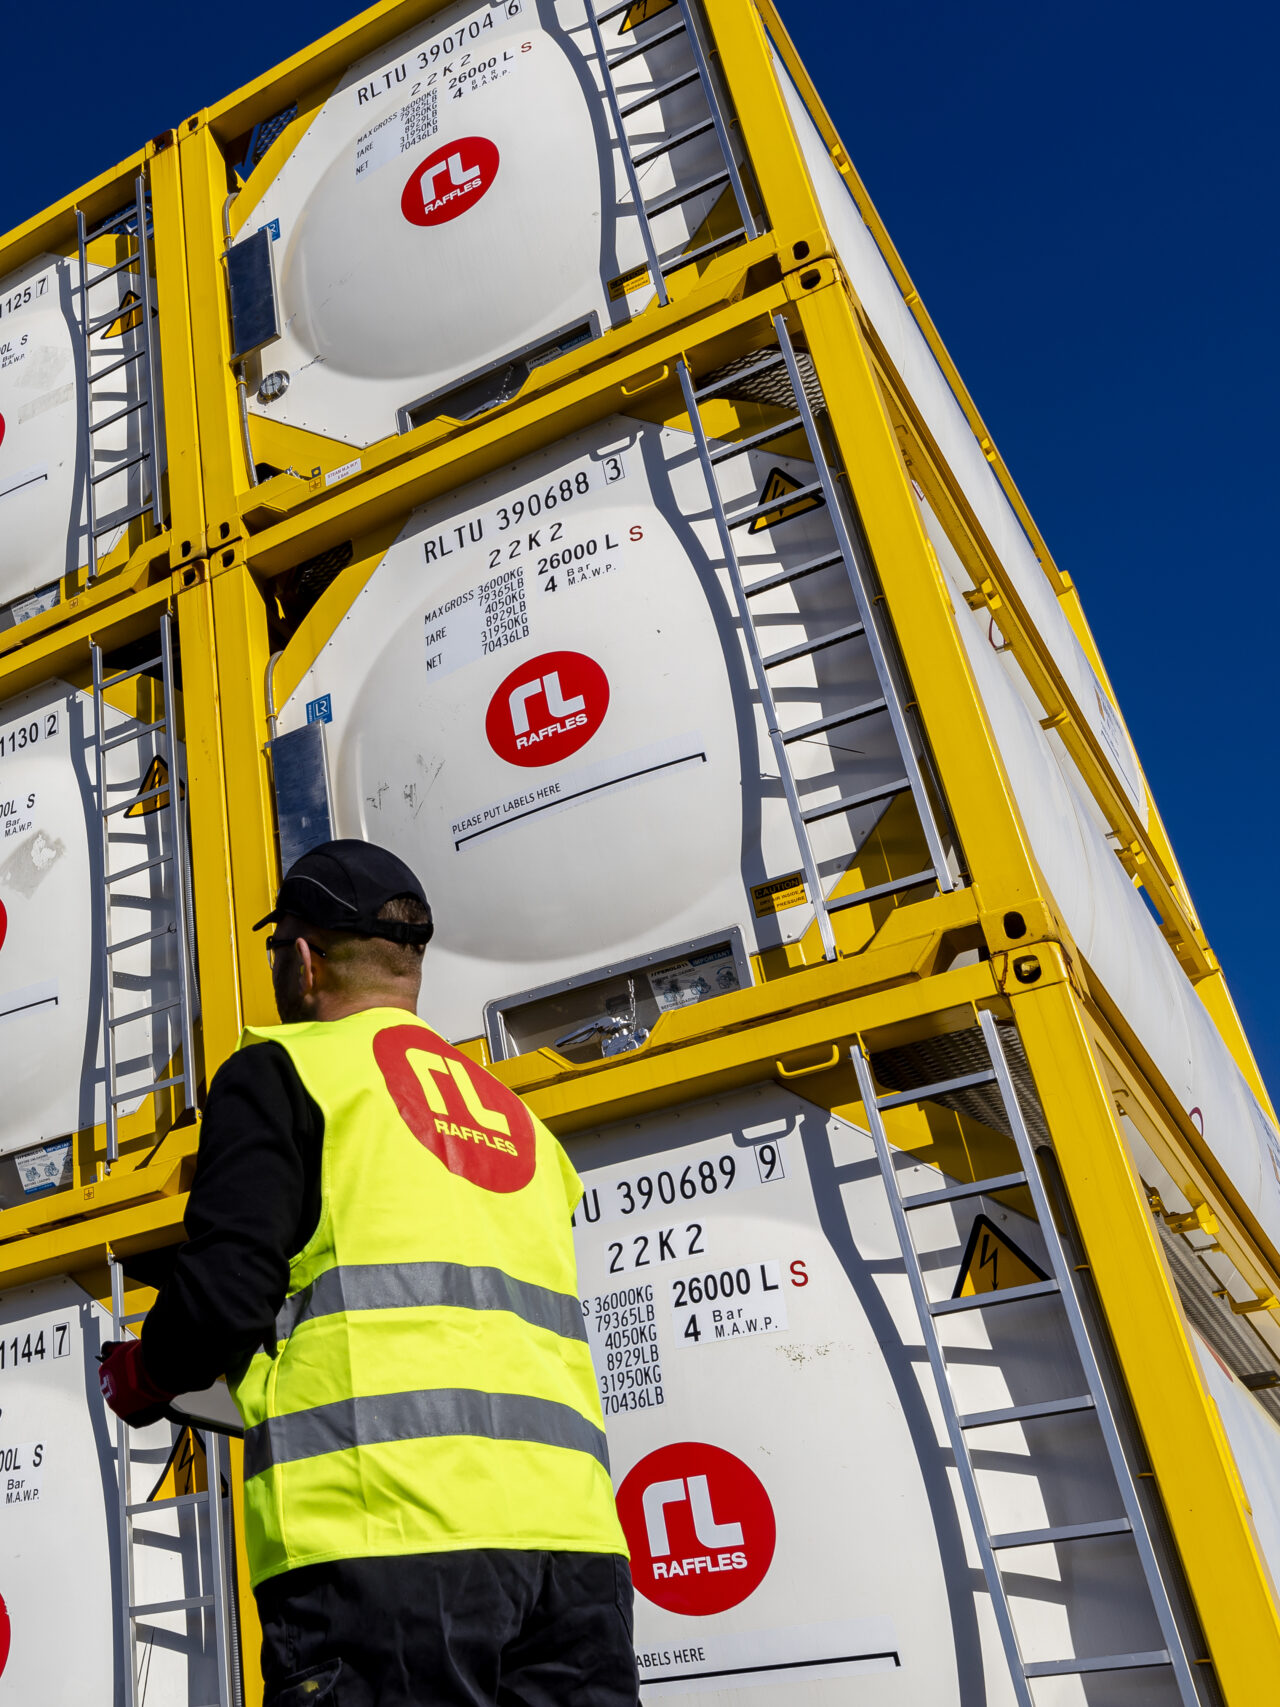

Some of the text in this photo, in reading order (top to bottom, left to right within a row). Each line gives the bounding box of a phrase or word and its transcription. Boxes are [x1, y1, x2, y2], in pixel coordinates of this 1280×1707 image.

[357, 12, 493, 105] RLTU 390704
[448, 42, 532, 90] 26000 S
[452, 87, 463, 100] 4
[356, 142, 374, 158] TARE
[356, 161, 369, 175] NET
[424, 178, 482, 214] RAFFLES
[20, 334, 29, 345] S
[424, 458, 621, 563] RLTU 390688 3
[489, 523, 563, 569] 22K2
[537, 526, 644, 576] 26000 L S
[478, 567, 524, 596] 36000KG
[544, 576, 557, 593] 4
[567, 564, 617, 586] M.A.W.P.
[478, 578, 524, 607] 79365LB
[426, 589, 525, 647] TARE 4050KG
[486, 601, 526, 627] 8929LB
[426, 613, 528, 671] NET 31950KG
[483, 626, 530, 655] 70436LB
[48, 714, 56, 736] 2
[515, 713, 588, 750] RAFFLES
[27, 793, 35, 808] S
[452, 782, 562, 835] PLEASE PUT LABELS HERE
[756, 879, 798, 898] CAUTION
[777, 896, 804, 907] PRESSURE
[434, 1119, 518, 1156] RAFFLES
[617, 1155, 736, 1215] 390689
[759, 1144, 777, 1180] 9
[608, 1223, 704, 1274] 22K2
[672, 1260, 809, 1308] 26000 L S
[595, 1284, 653, 1314] 36000KG
[596, 1304, 655, 1333] 79365LB
[684, 1307, 744, 1342] 4 Bar
[714, 1316, 778, 1338] M.A.W.P.
[56, 1325, 67, 1355] 7
[605, 1324, 657, 1350] 4050KG
[607, 1344, 659, 1371] 8929LB
[600, 1364, 662, 1394] 31950KG
[603, 1386, 664, 1416] 70436LB
[33, 1444, 43, 1467] S
[6, 1488, 39, 1504] M.A.W.P.
[7, 1478, 25, 1490] Bar
[653, 1552, 748, 1580] RAFFLES
[674, 1647, 705, 1664] HERE
